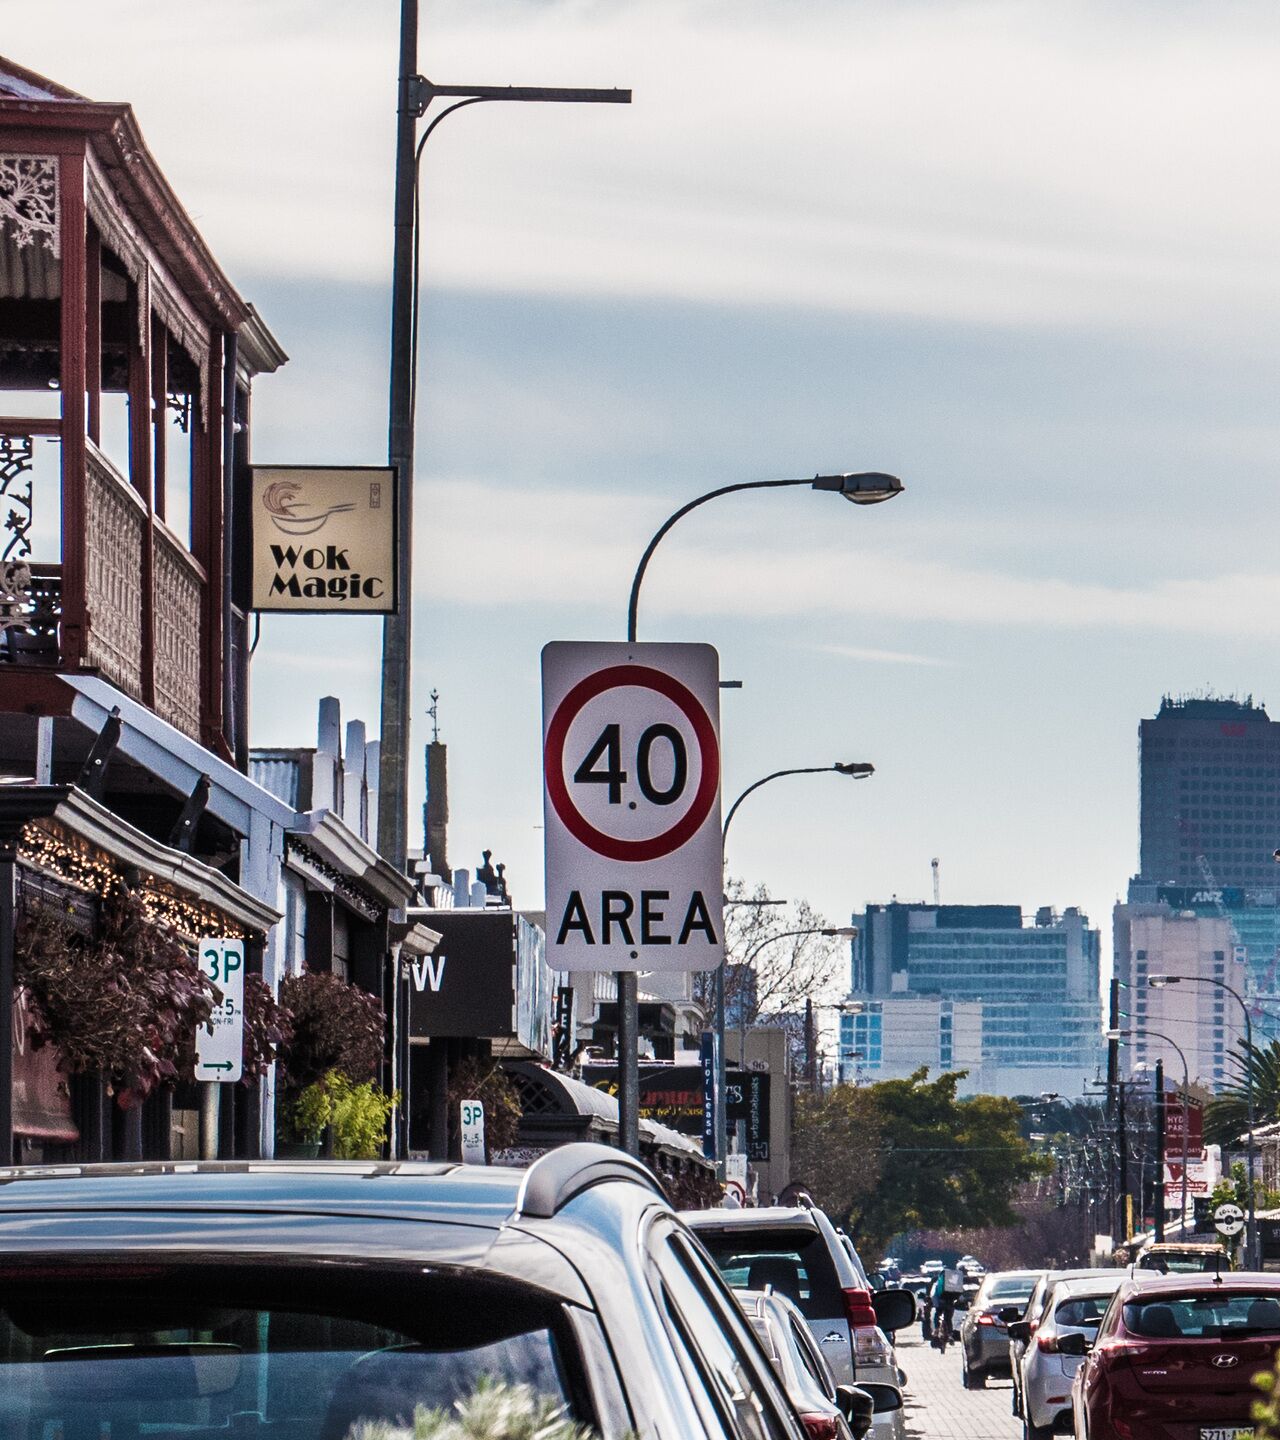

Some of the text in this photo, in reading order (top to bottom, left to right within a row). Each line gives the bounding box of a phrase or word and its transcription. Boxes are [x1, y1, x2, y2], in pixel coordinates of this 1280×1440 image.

[269, 545, 350, 570] Wok
[269, 573, 384, 601] Magic
[574, 723, 687, 805] 40
[556, 890, 718, 945] AREA
[204, 949, 241, 983] 3P
[704, 1092, 712, 1136] Lease
[1167, 1115, 1184, 1124] HYD
